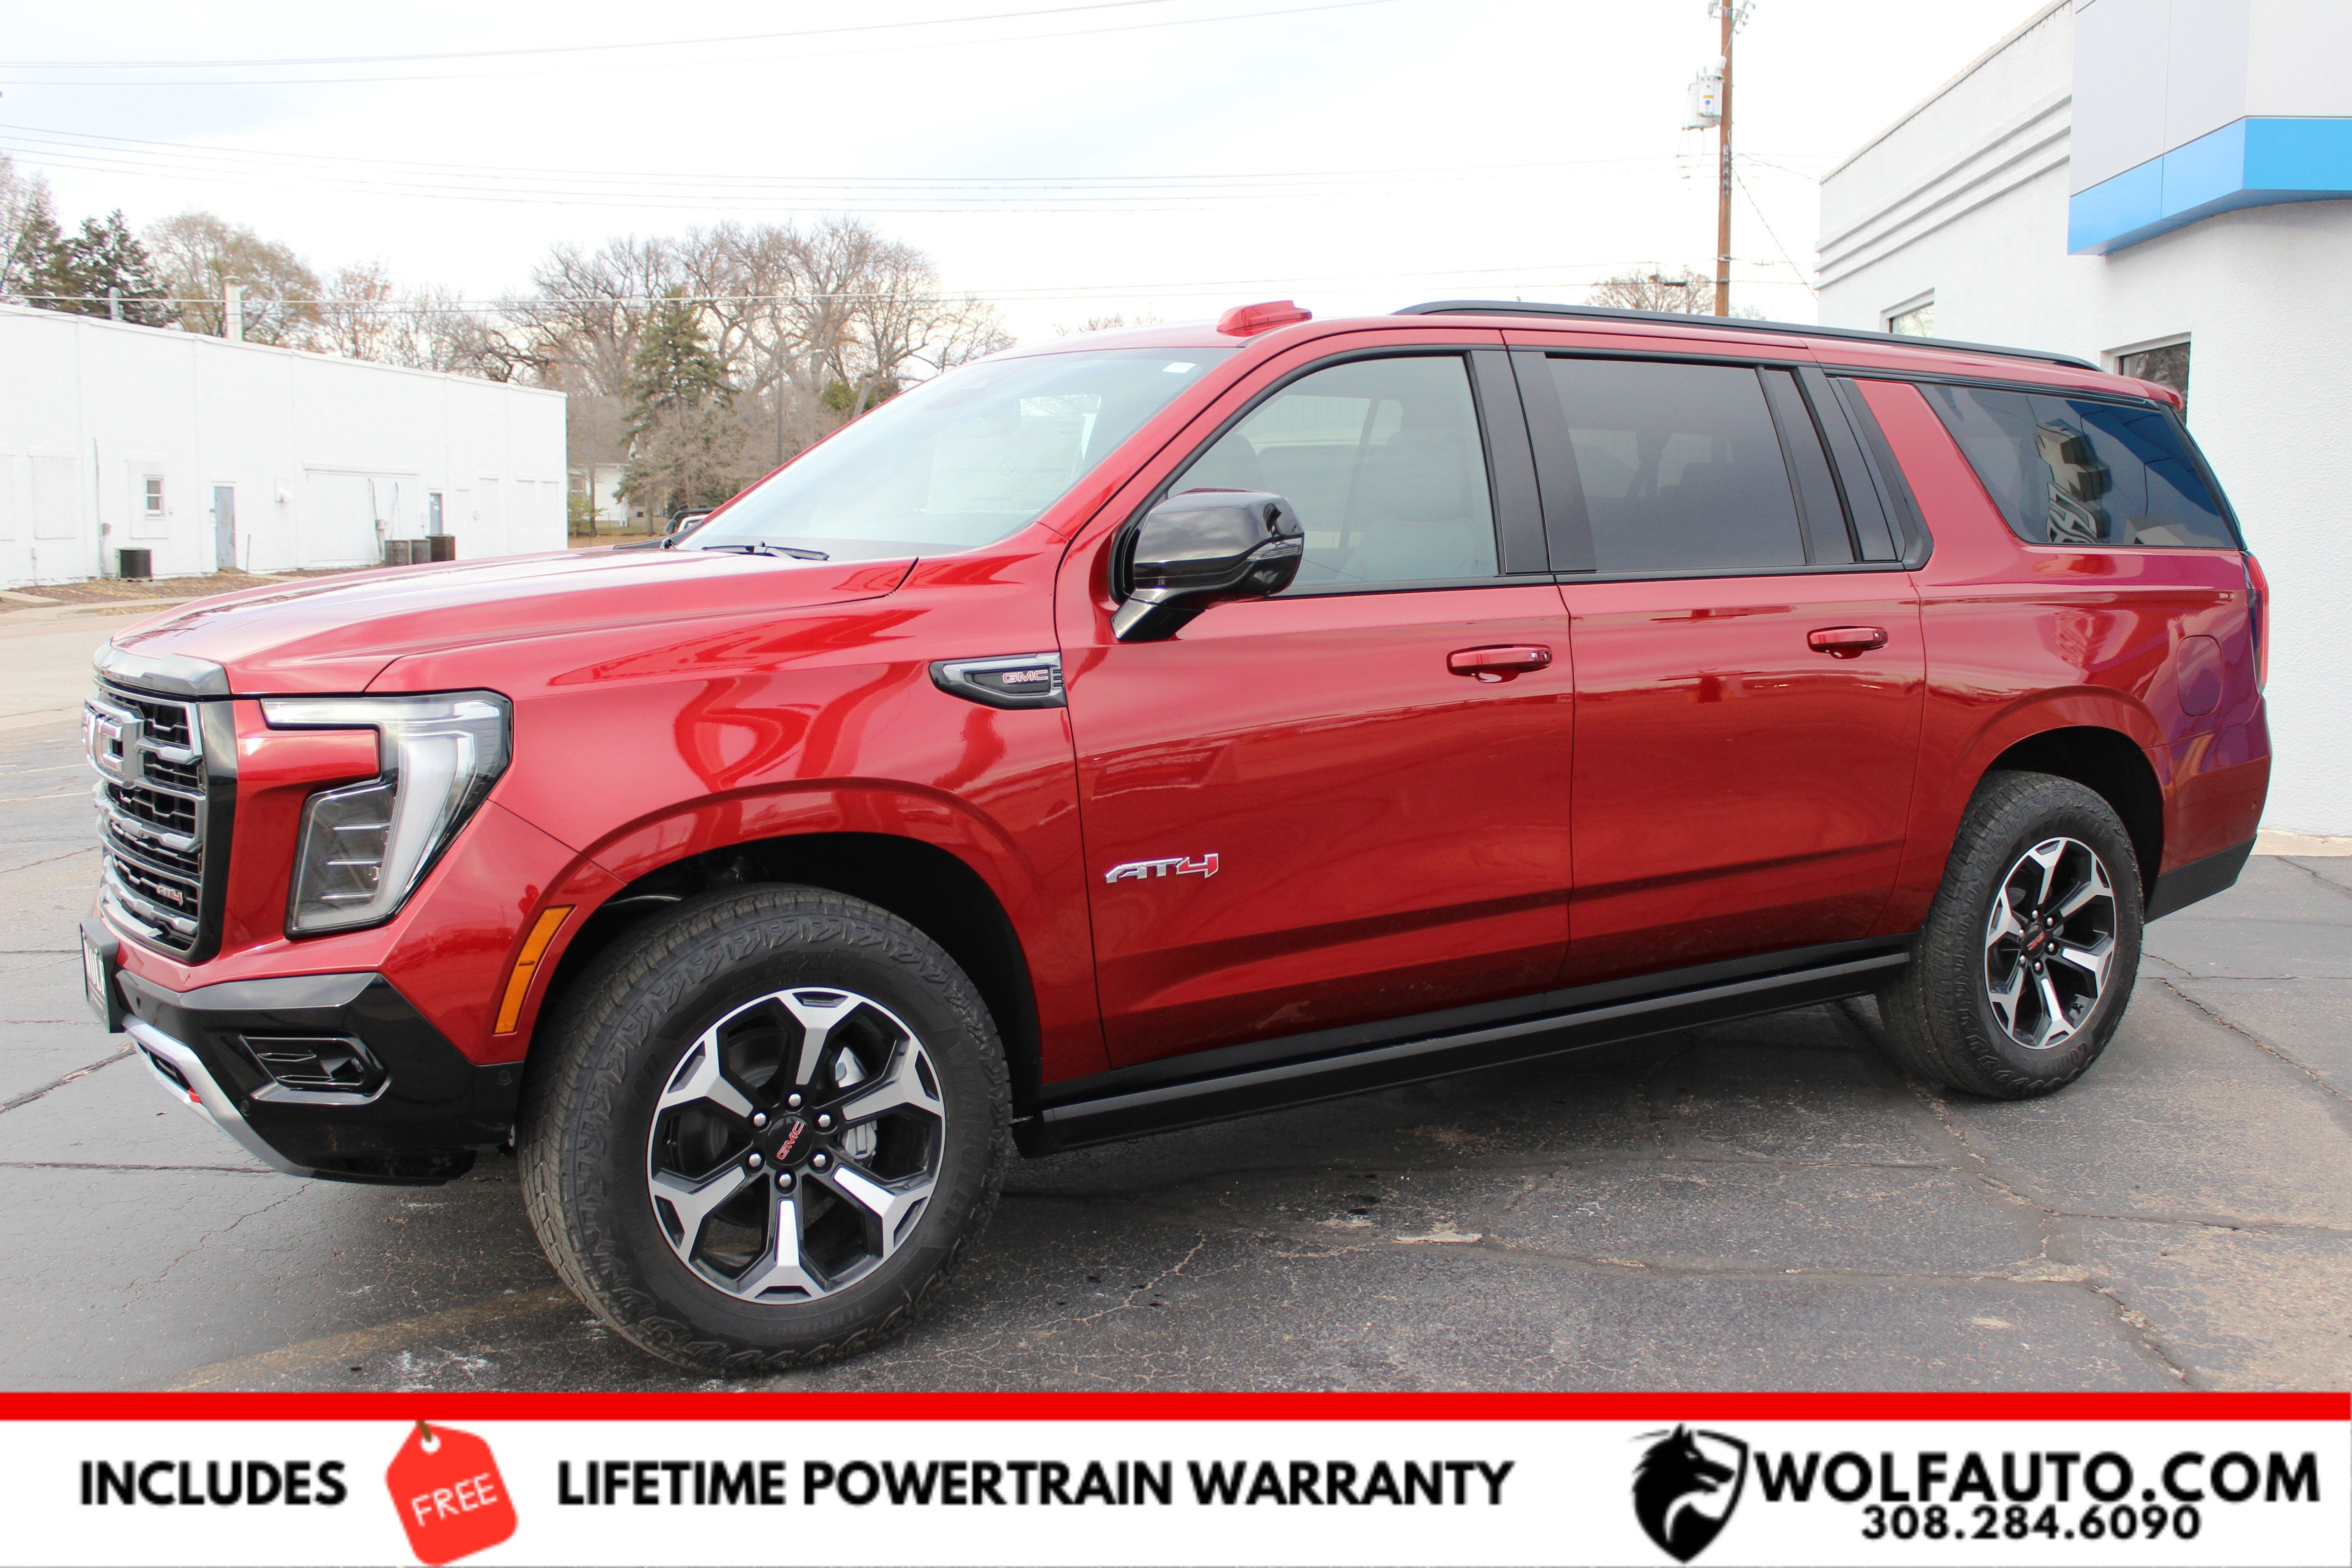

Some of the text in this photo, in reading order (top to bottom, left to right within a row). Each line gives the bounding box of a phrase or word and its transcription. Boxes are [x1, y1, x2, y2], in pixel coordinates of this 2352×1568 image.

[1003, 670, 1049, 683] GMC
[1105, 853, 1219, 884] AT4
[2027, 931, 2045, 951] GMC
[777, 1120, 804, 1160] GMC
